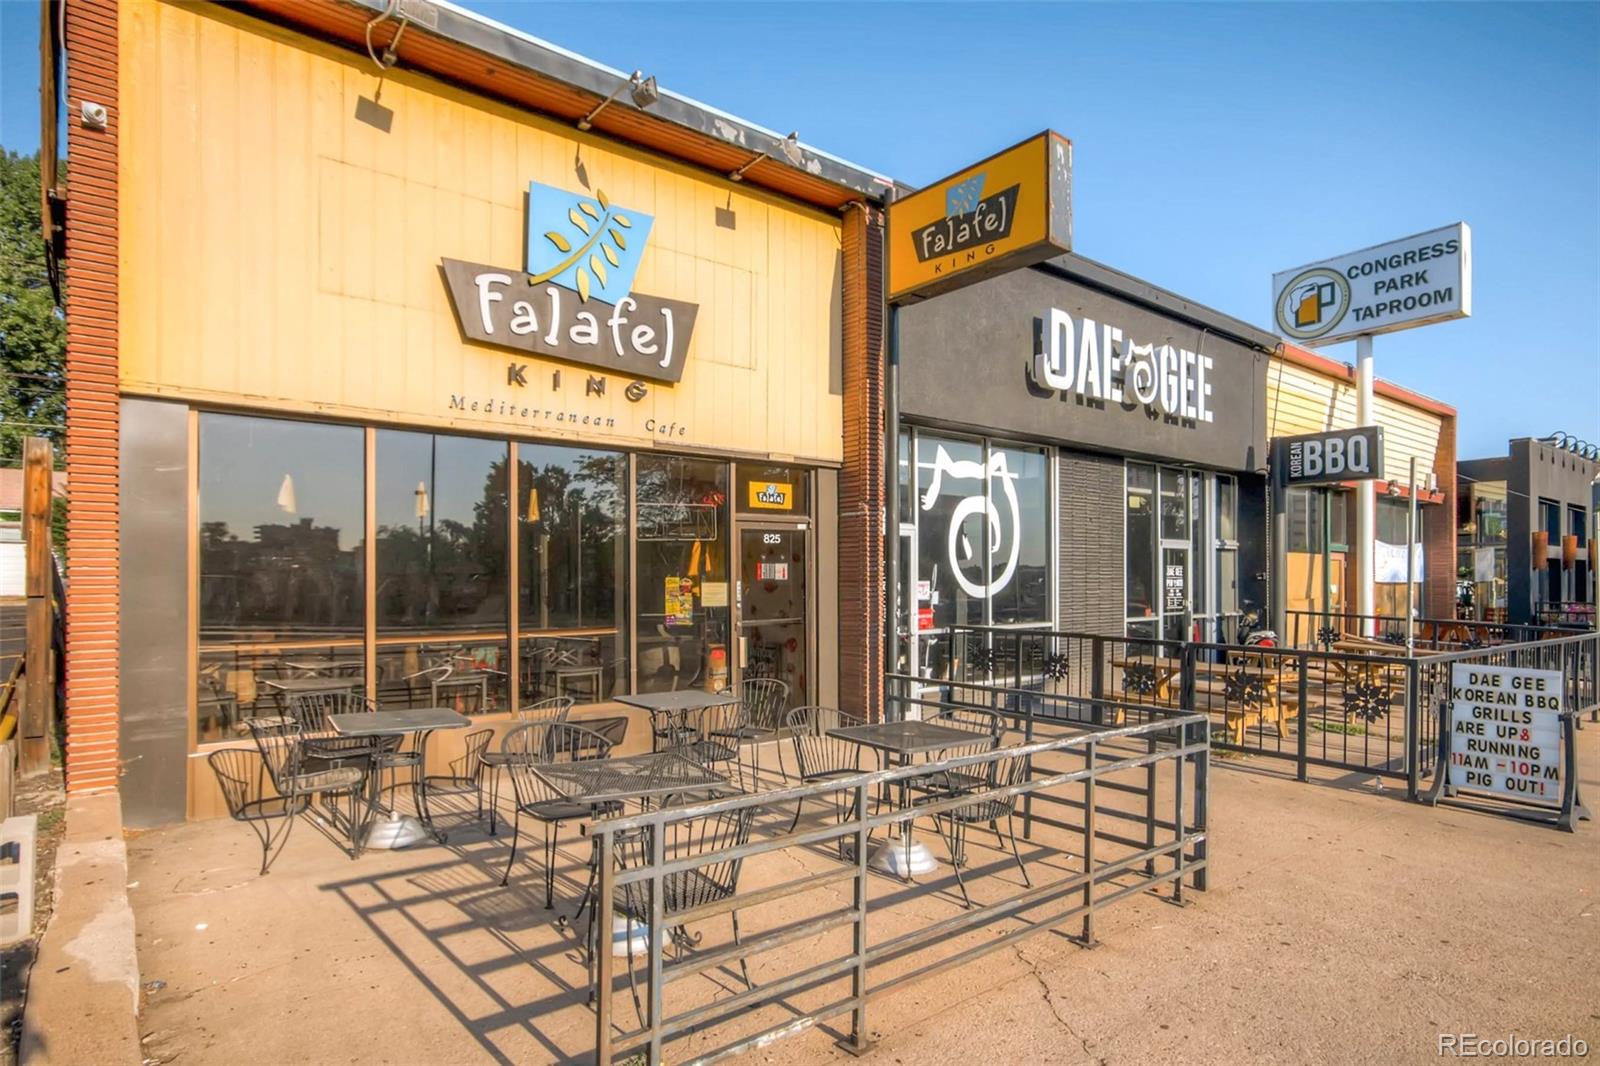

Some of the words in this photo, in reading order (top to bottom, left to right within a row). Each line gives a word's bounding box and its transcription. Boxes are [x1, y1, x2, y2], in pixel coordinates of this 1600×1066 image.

[922, 196, 1007, 259] Falafel
[934, 244, 995, 273] KING
[1347, 239, 1459, 280] CONGRESS
[1374, 270, 1429, 296] PARK
[1352, 287, 1453, 322] TAPROOM
[474, 272, 674, 368] Falafel
[1042, 307, 1123, 403] DAE
[1160, 344, 1213, 423] GEE
[507, 362, 648, 403] KING
[448, 395, 615, 428] Mediterranean
[645, 419, 686, 436] Cafe
[1290, 442, 1302, 478] KOREAN
[1304, 434, 1370, 476] BBQ
[763, 533, 781, 544] 825
[1469, 672, 1500, 687] DAE
[1511, 676, 1545, 691] GEE
[1453, 688, 1516, 706] KOREAN
[1525, 695, 1559, 710] BBQ
[1456, 721, 1485, 735] ARE
[1472, 706, 1532, 724] GRILLS
[1451, 752, 1489, 769] 11AM
[1467, 739, 1540, 759] RUNNING
[1466, 772, 1492, 787] PIG
[1505, 777, 1545, 795] OUT!
